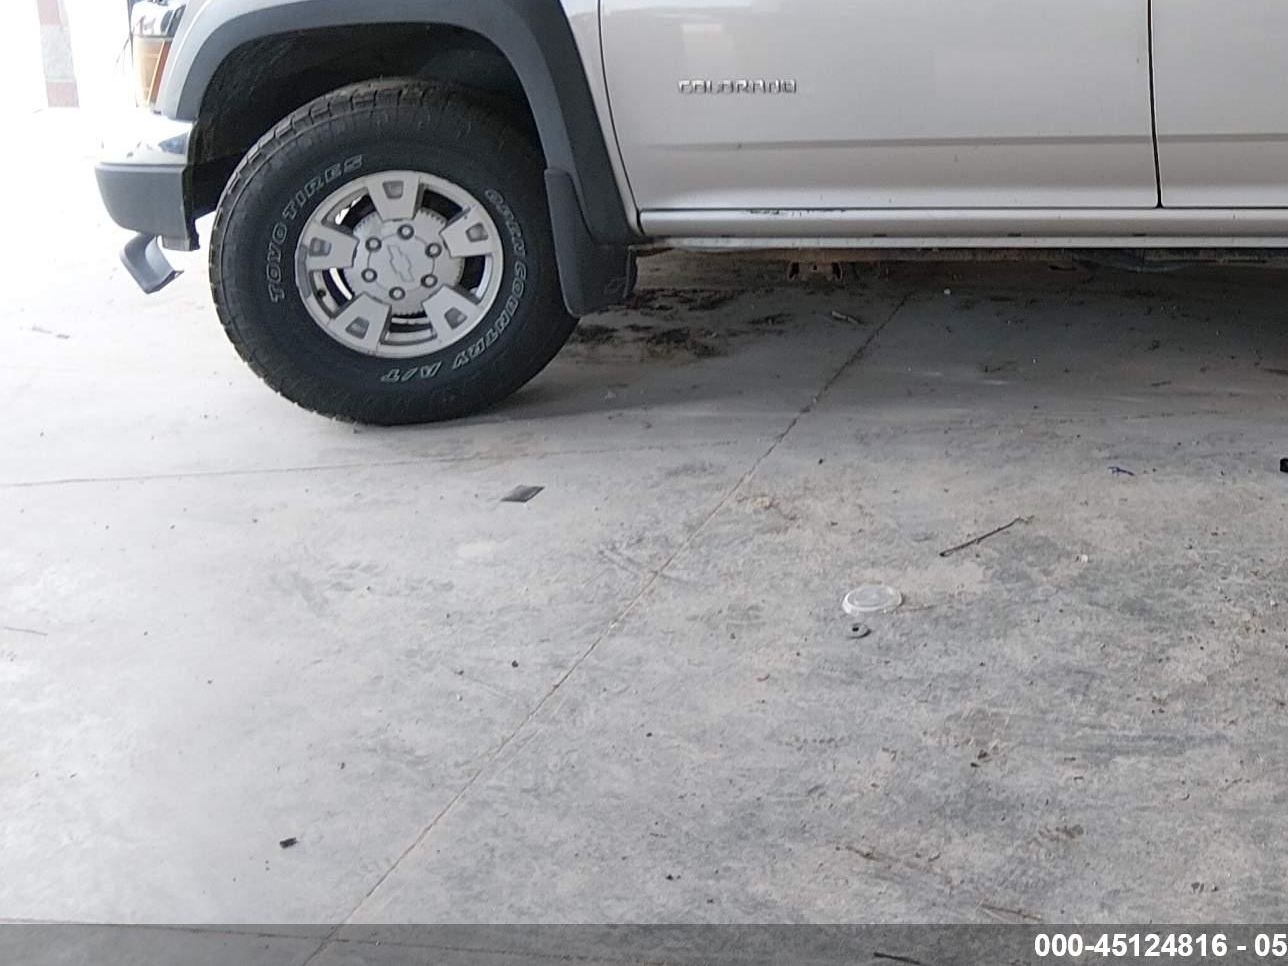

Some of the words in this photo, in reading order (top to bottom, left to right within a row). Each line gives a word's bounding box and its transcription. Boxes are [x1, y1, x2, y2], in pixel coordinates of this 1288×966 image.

[678, 78, 798, 95] COLORADO
[265, 223, 290, 303] TOYO
[281, 153, 364, 220] TIRES
[452, 259, 528, 370] COUNTRY
[380, 360, 442, 383] A/T
